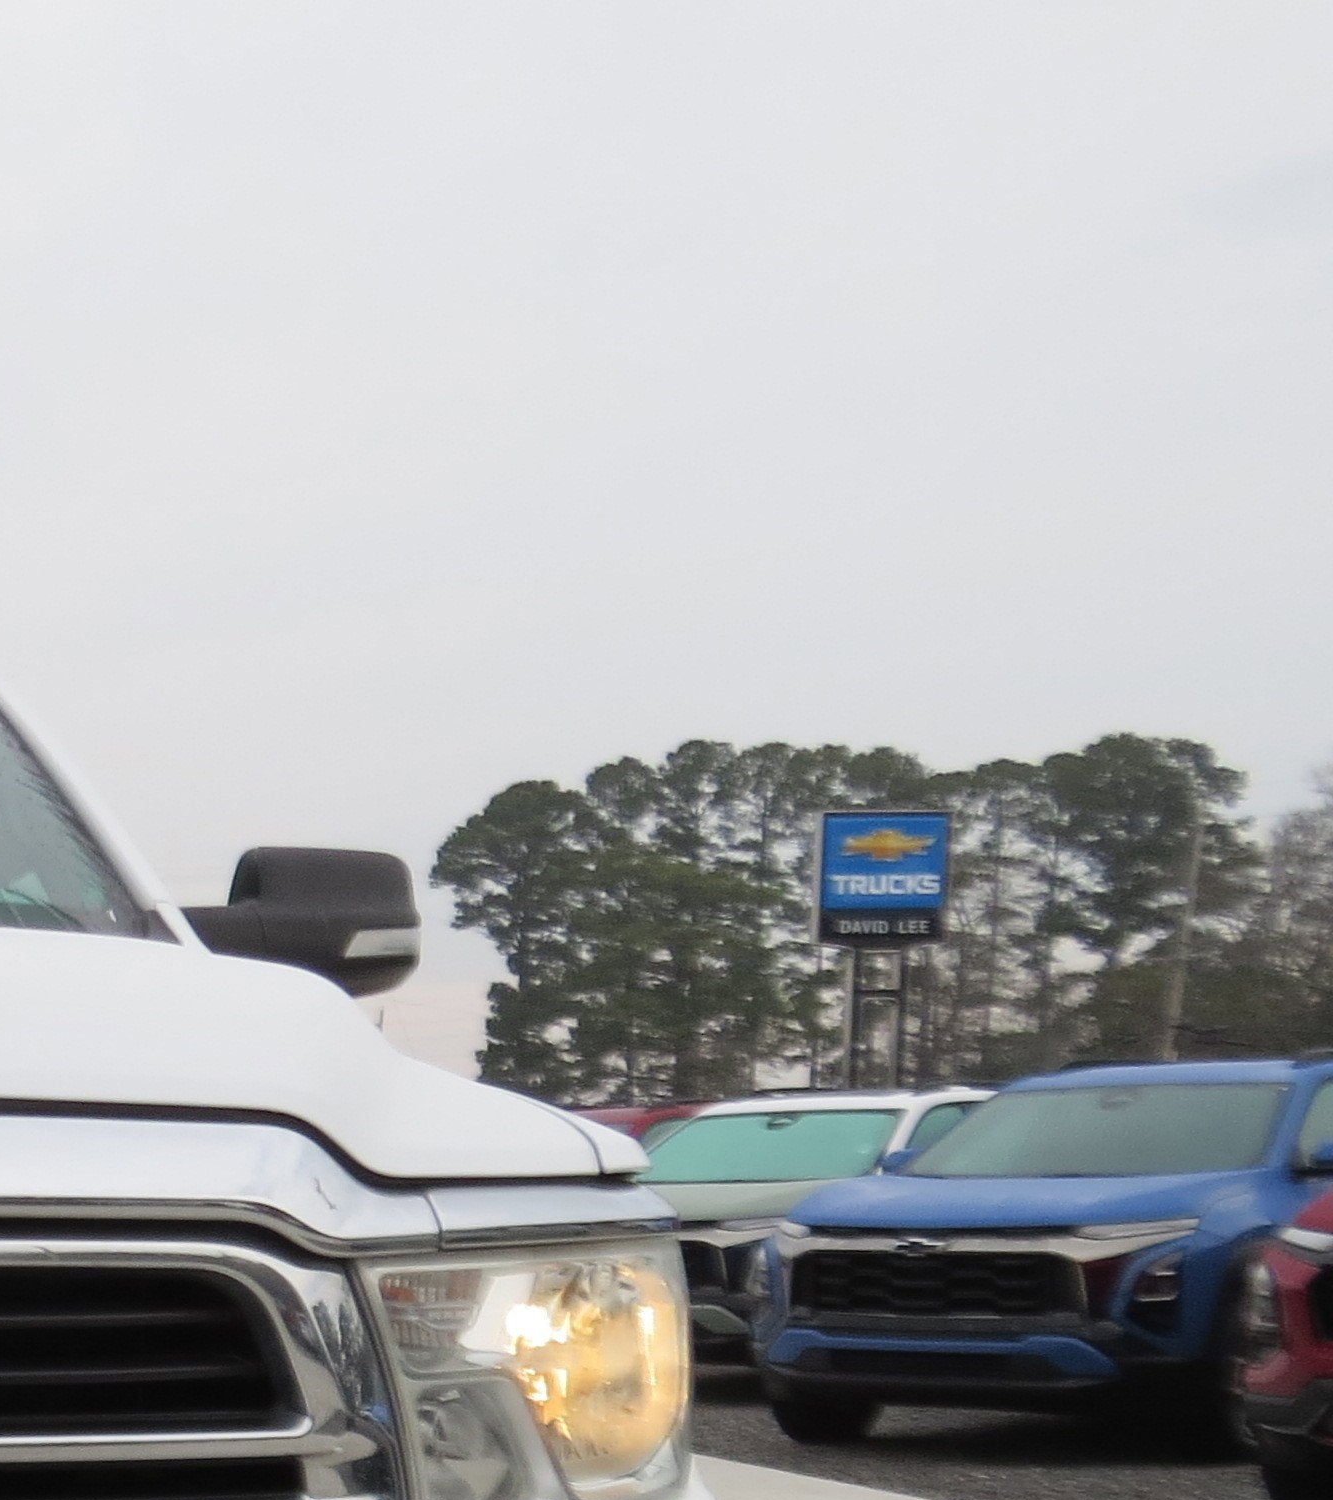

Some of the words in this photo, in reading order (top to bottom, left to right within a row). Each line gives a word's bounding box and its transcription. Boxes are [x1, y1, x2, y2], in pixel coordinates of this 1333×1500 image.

[830, 874, 940, 895] TRUCKS
[839, 920, 889, 934] DAVID
[898, 920, 930, 934] LEE
